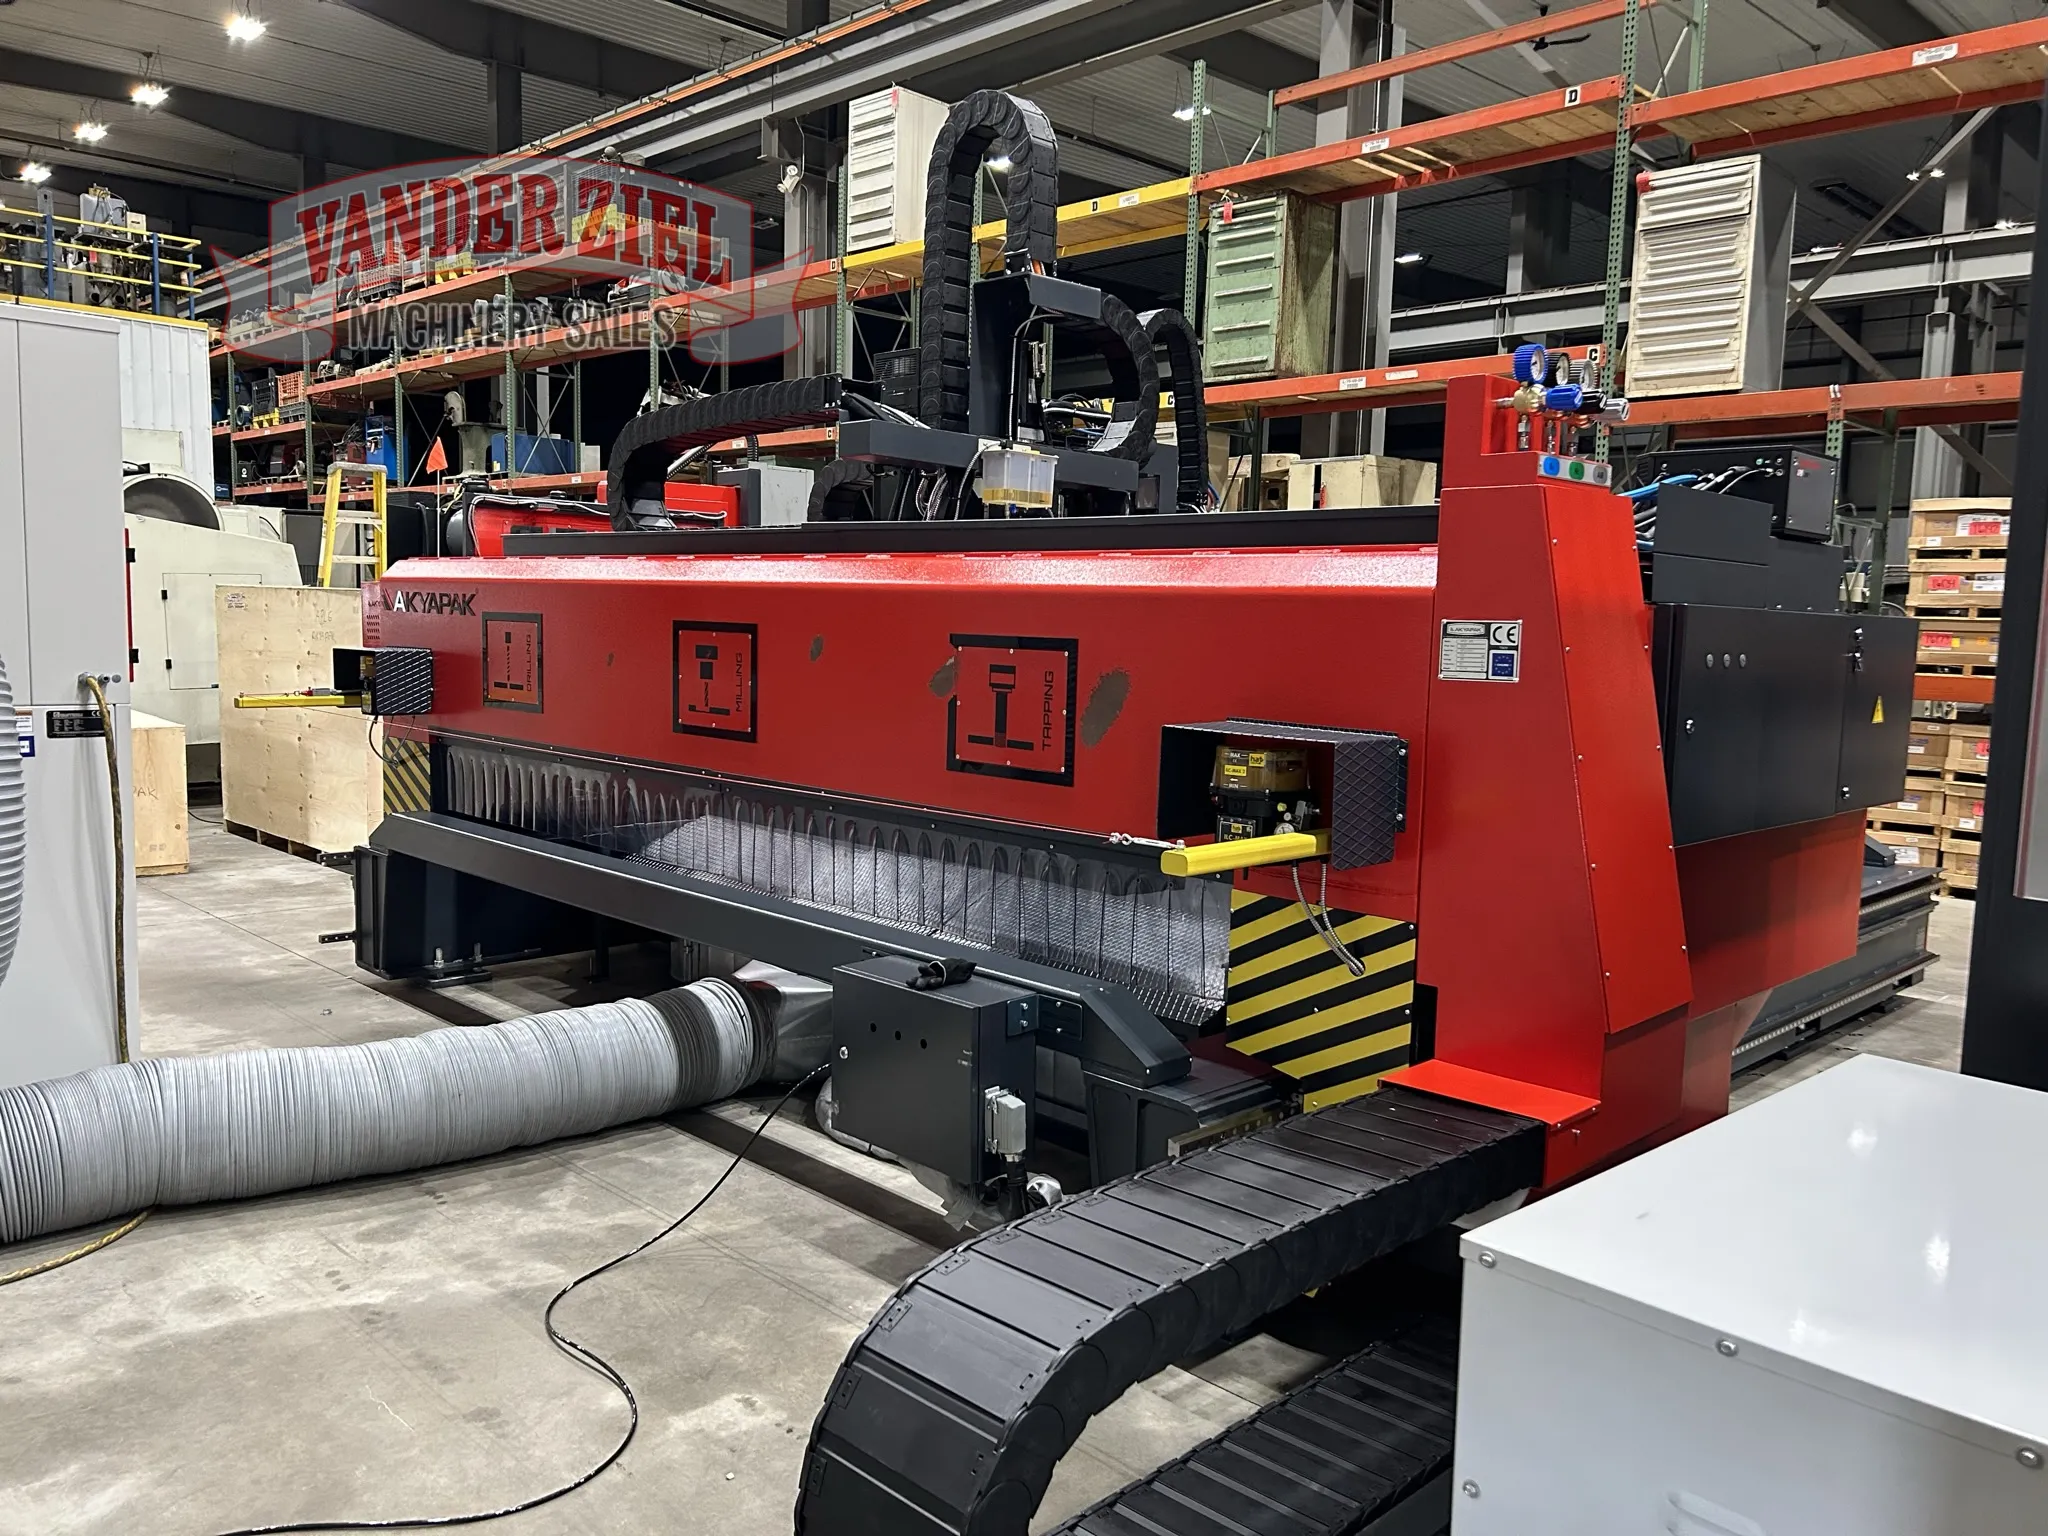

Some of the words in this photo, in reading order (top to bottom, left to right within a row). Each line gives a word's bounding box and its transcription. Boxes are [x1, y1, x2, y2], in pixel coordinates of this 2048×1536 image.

[1568, 89, 1578, 103] D
[1092, 201, 1098, 211] D
[1588, 348, 1598, 362] C
[1167, 395, 1175, 405] C
[827, 430, 832, 438] C
[393, 590, 476, 616] AKYAPAK
[1492, 625, 1517, 644] CE
[735, 652, 743, 712] MILLING
[1042, 670, 1054, 752] TAPPING
